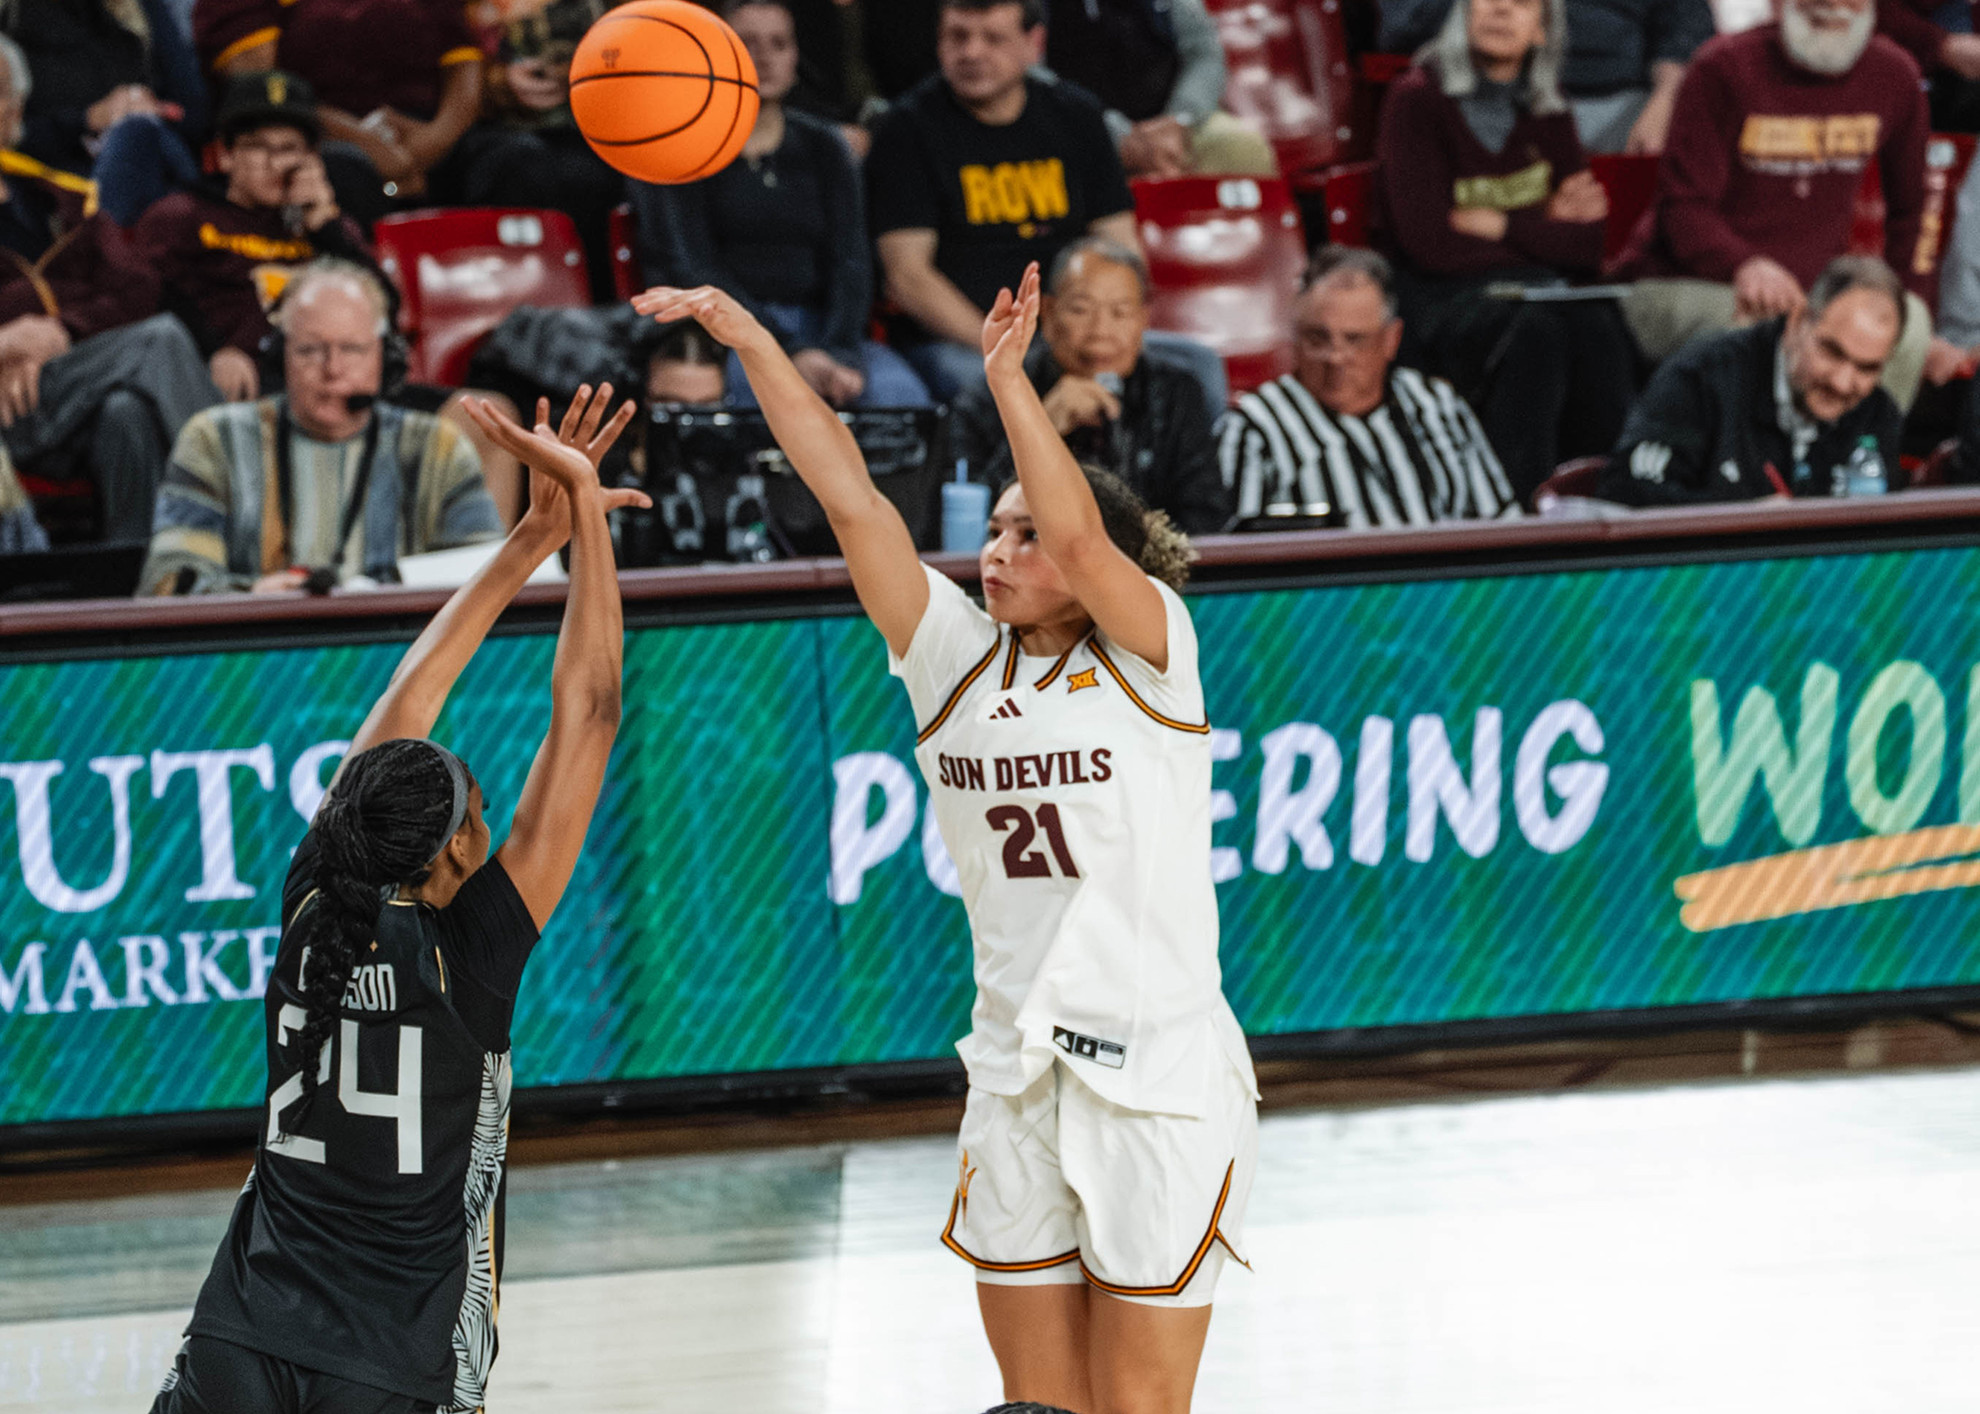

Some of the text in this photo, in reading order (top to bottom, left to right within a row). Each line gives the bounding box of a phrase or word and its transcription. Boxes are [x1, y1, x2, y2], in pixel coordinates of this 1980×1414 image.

[938, 747, 1112, 792] SUN DEVILS
[1691, 659, 1980, 847] WO
[985, 802, 1080, 879] 21
[265, 1002, 423, 1174] 24
